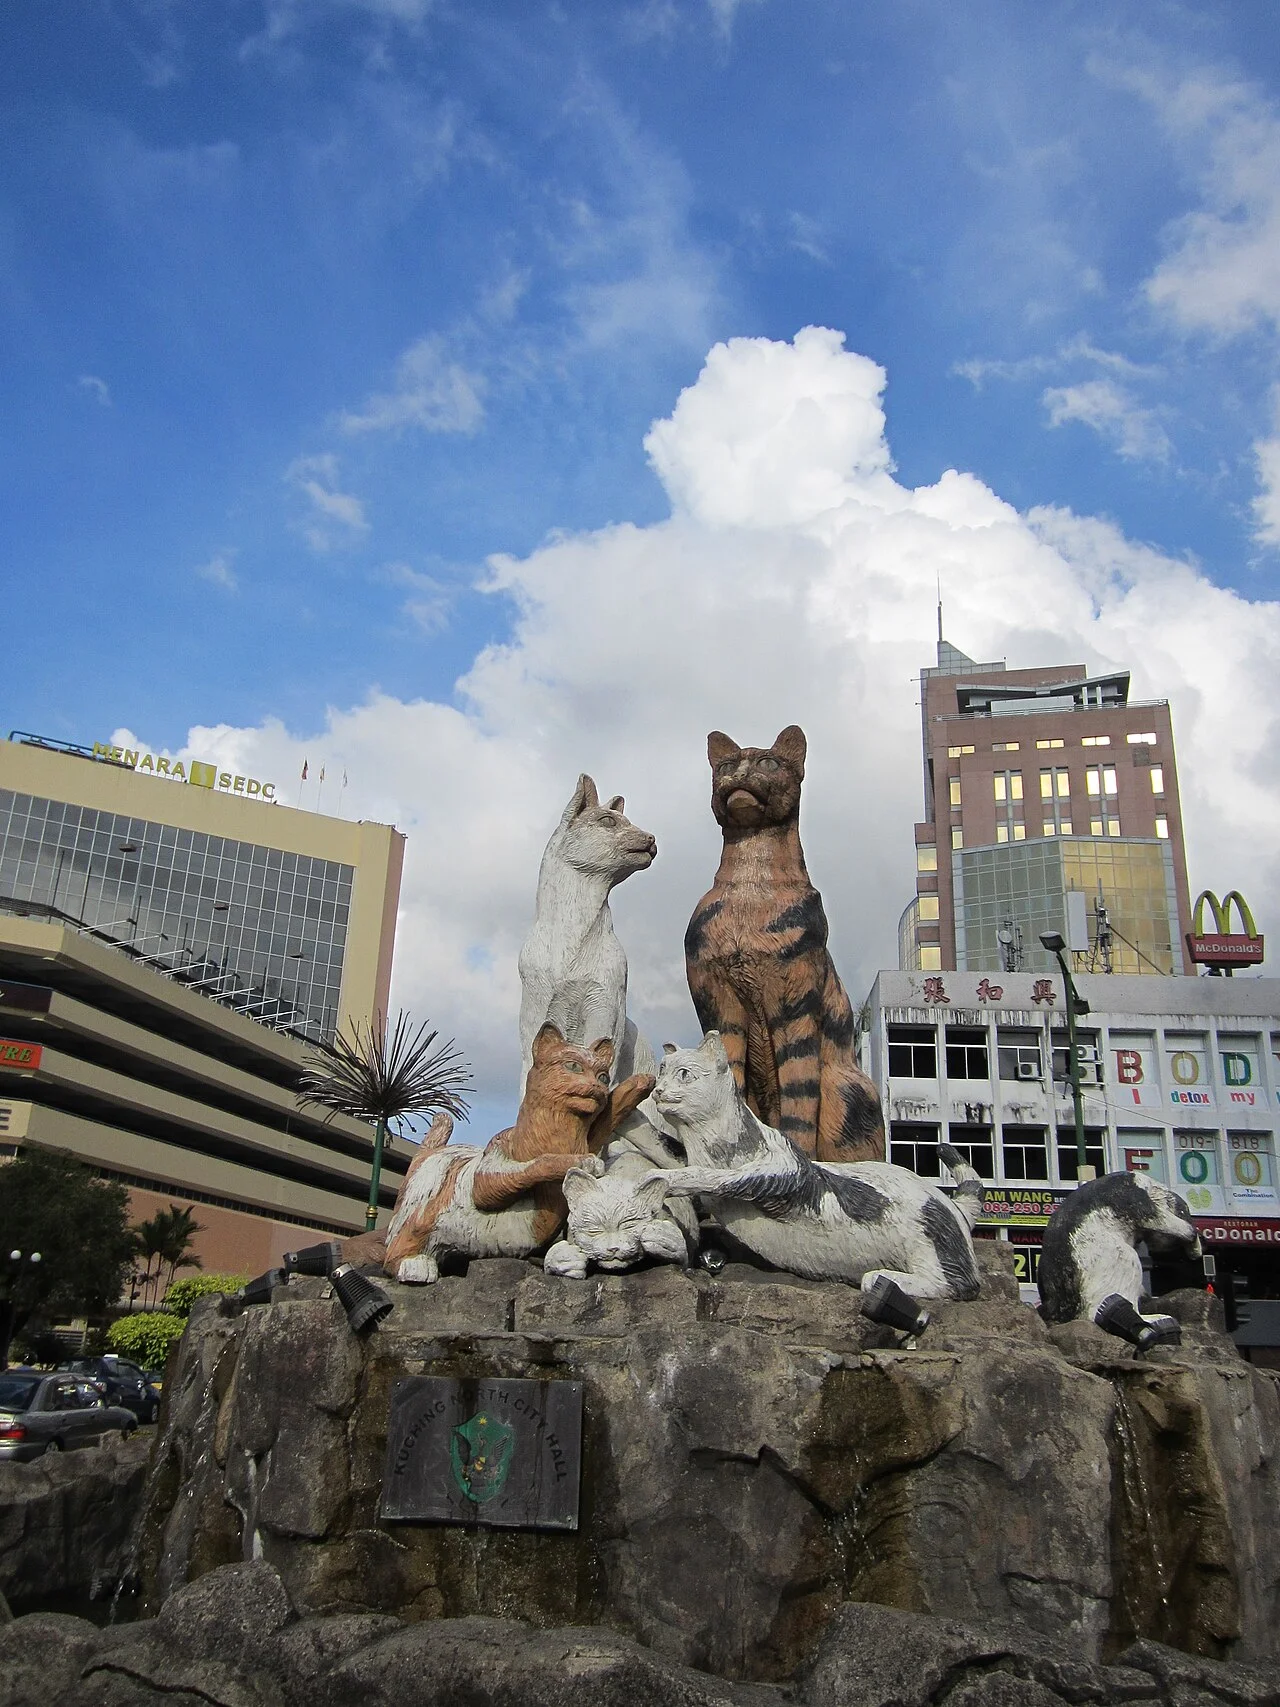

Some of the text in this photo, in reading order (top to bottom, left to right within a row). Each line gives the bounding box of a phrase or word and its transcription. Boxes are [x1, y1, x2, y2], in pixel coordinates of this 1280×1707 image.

[92, 742, 275, 798] MENARA SEDC
[1195, 943, 1262, 954] McDonald's
[1116, 1050, 1280, 1087] BOD
[1170, 1090, 1210, 1104] detox
[1230, 1092, 1255, 1105] my
[1009, 1191, 1052, 1203] WANG
[983, 1202, 1041, 1214] 082-250
[394, 1388, 567, 1482] KUCHING NORTH CITY HALL
